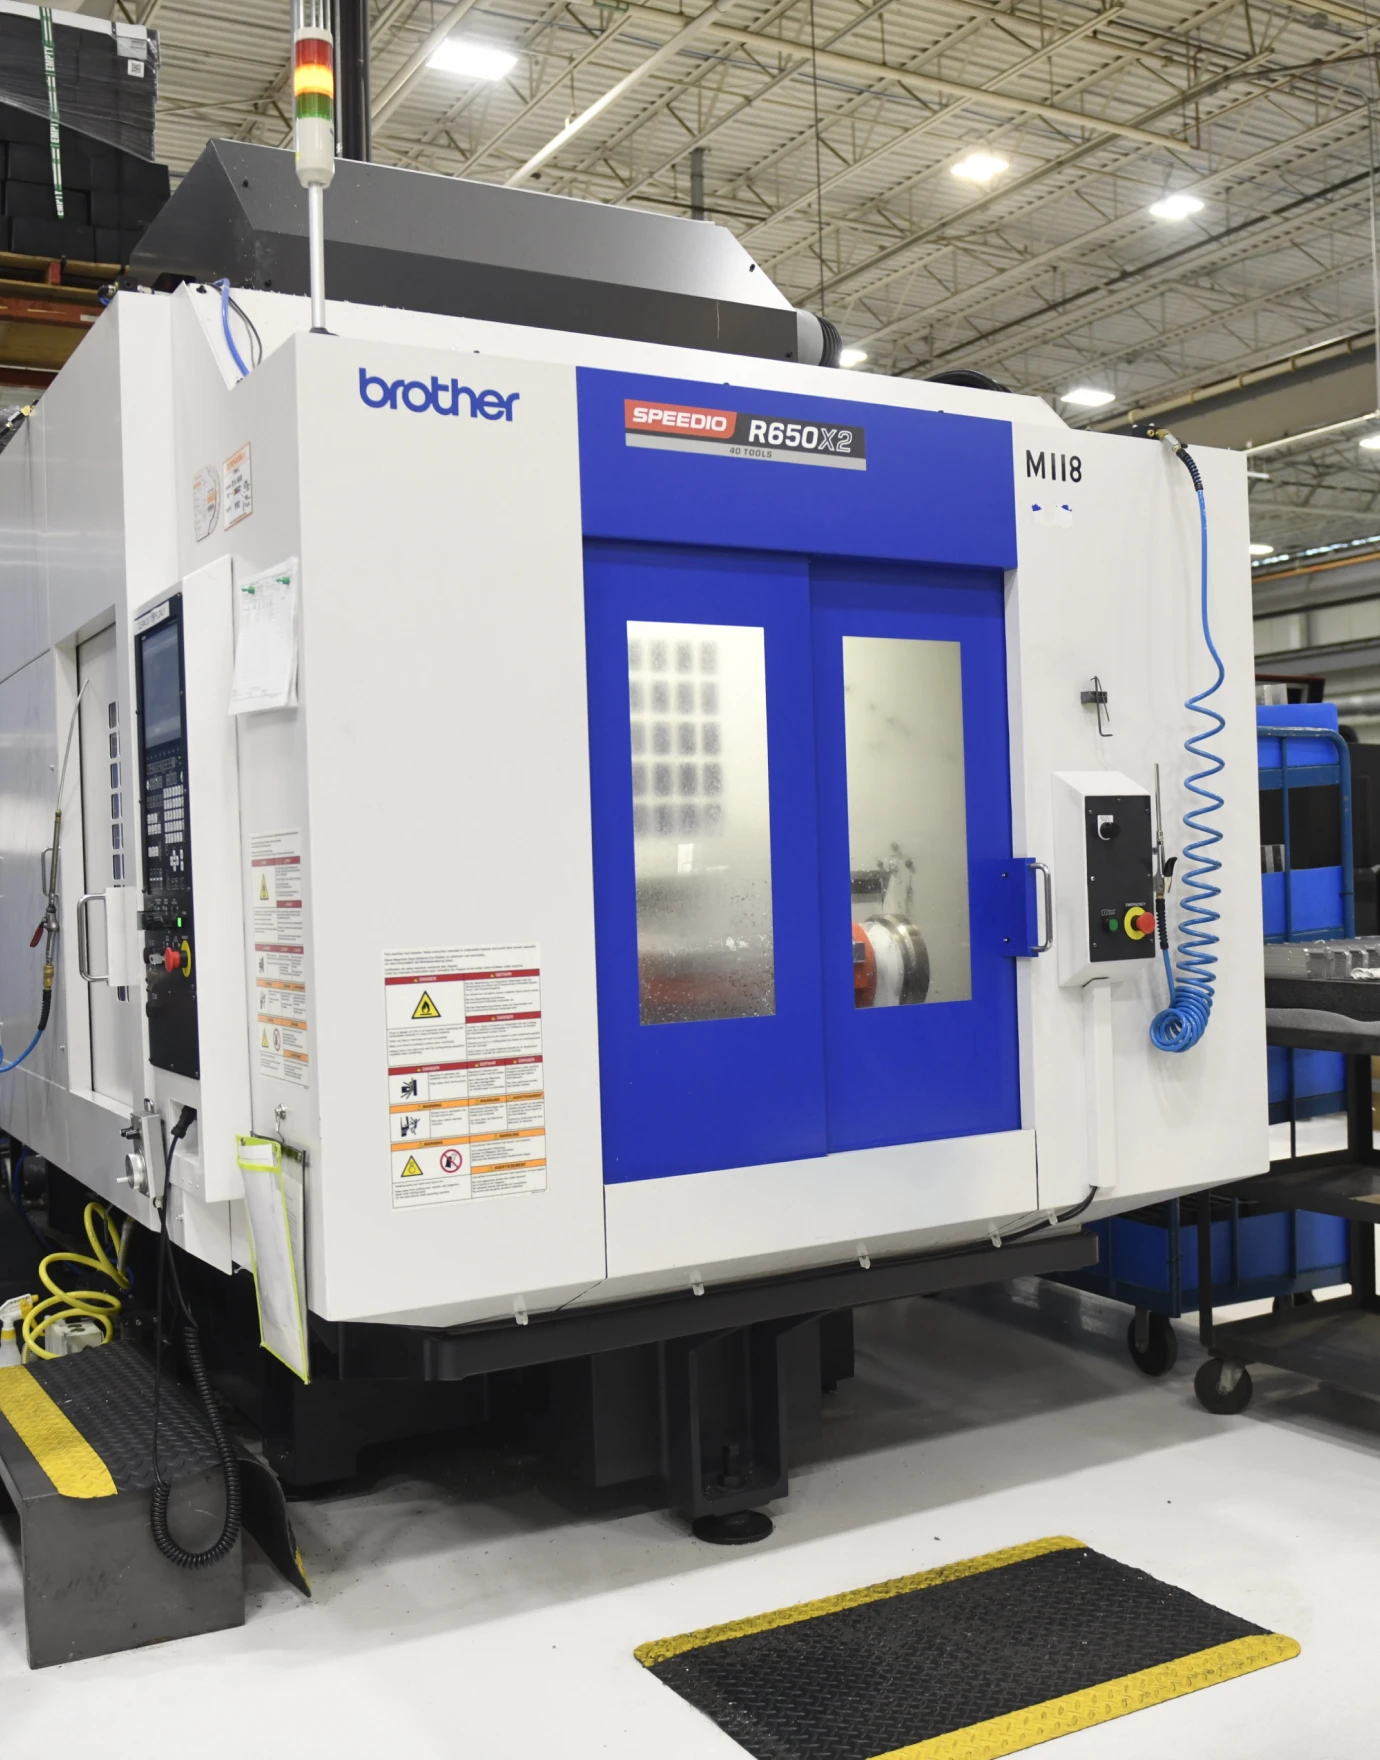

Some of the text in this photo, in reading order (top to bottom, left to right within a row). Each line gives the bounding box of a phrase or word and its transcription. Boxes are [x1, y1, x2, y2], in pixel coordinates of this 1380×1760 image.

[43, 45, 55, 72] EMPTY
[359, 367, 520, 422] brother
[632, 407, 853, 453] SPEEDIO R650X2
[729, 447, 772, 459] 40 TOOLS
[1026, 449, 1082, 483] M118
